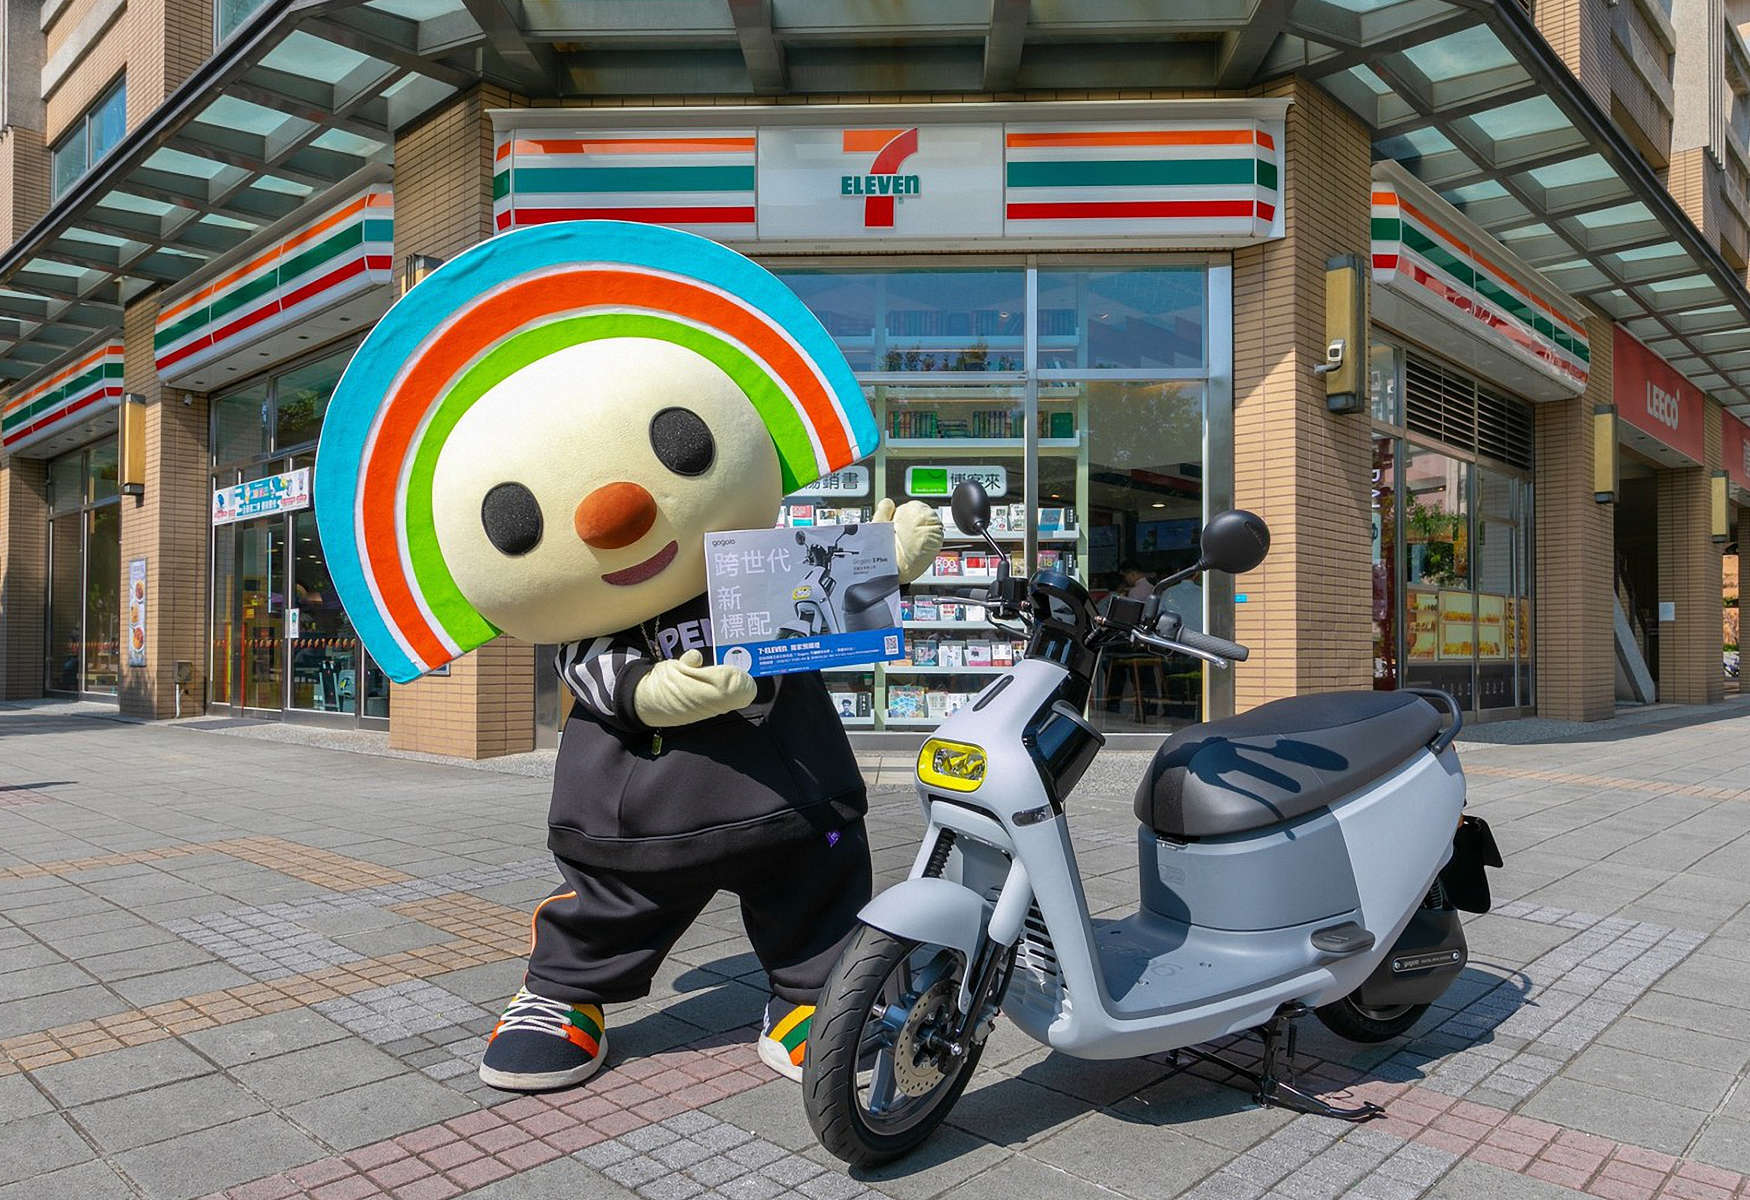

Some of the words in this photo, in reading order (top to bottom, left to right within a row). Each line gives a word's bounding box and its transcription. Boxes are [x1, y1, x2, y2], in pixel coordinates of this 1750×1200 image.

[842, 127, 918, 227] 7
[712, 539, 735, 547] gogoro
[714, 548, 791, 577] 跨世代
[717, 585, 742, 611] 新
[648, 617, 713, 660] PE
[719, 611, 772, 640] 標配
